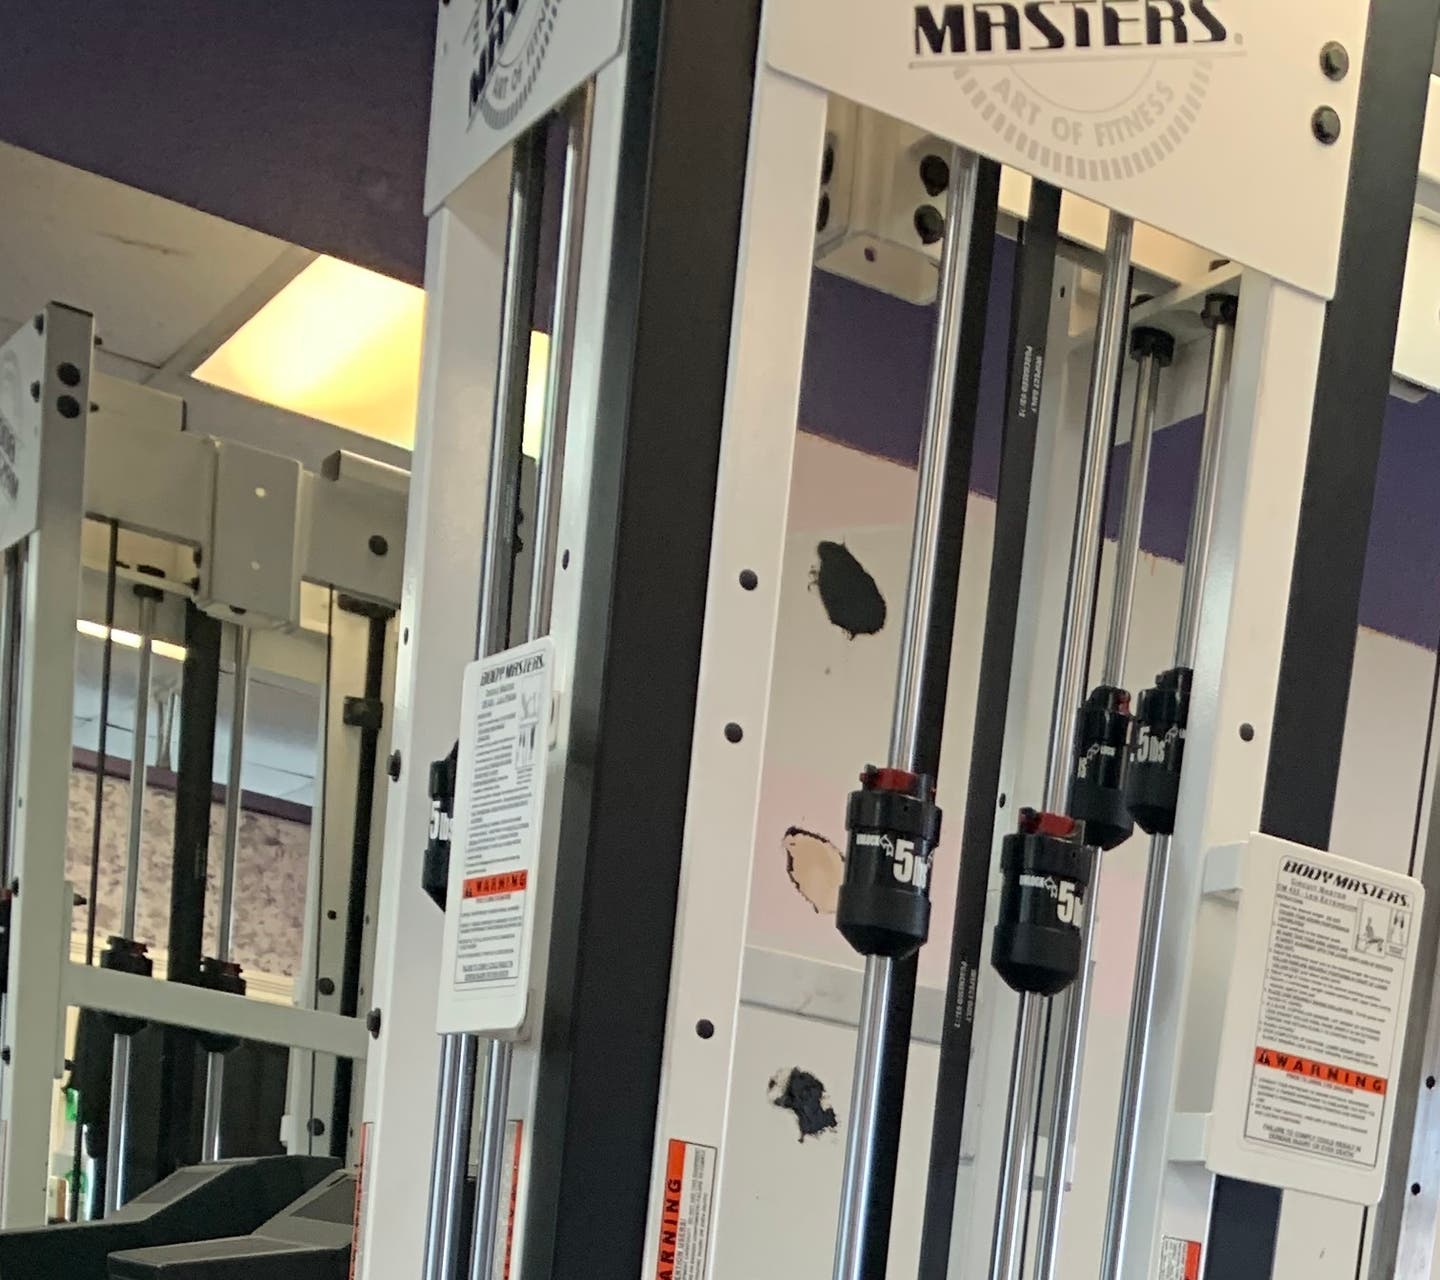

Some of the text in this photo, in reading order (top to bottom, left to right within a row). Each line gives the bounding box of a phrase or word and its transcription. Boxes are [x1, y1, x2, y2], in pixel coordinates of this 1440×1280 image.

[992, 77, 1175, 148] ART OF FITNESS
[1283, 860, 1409, 907] BODY MASTERS
[1276, 1055, 1382, 1092] WARNING
